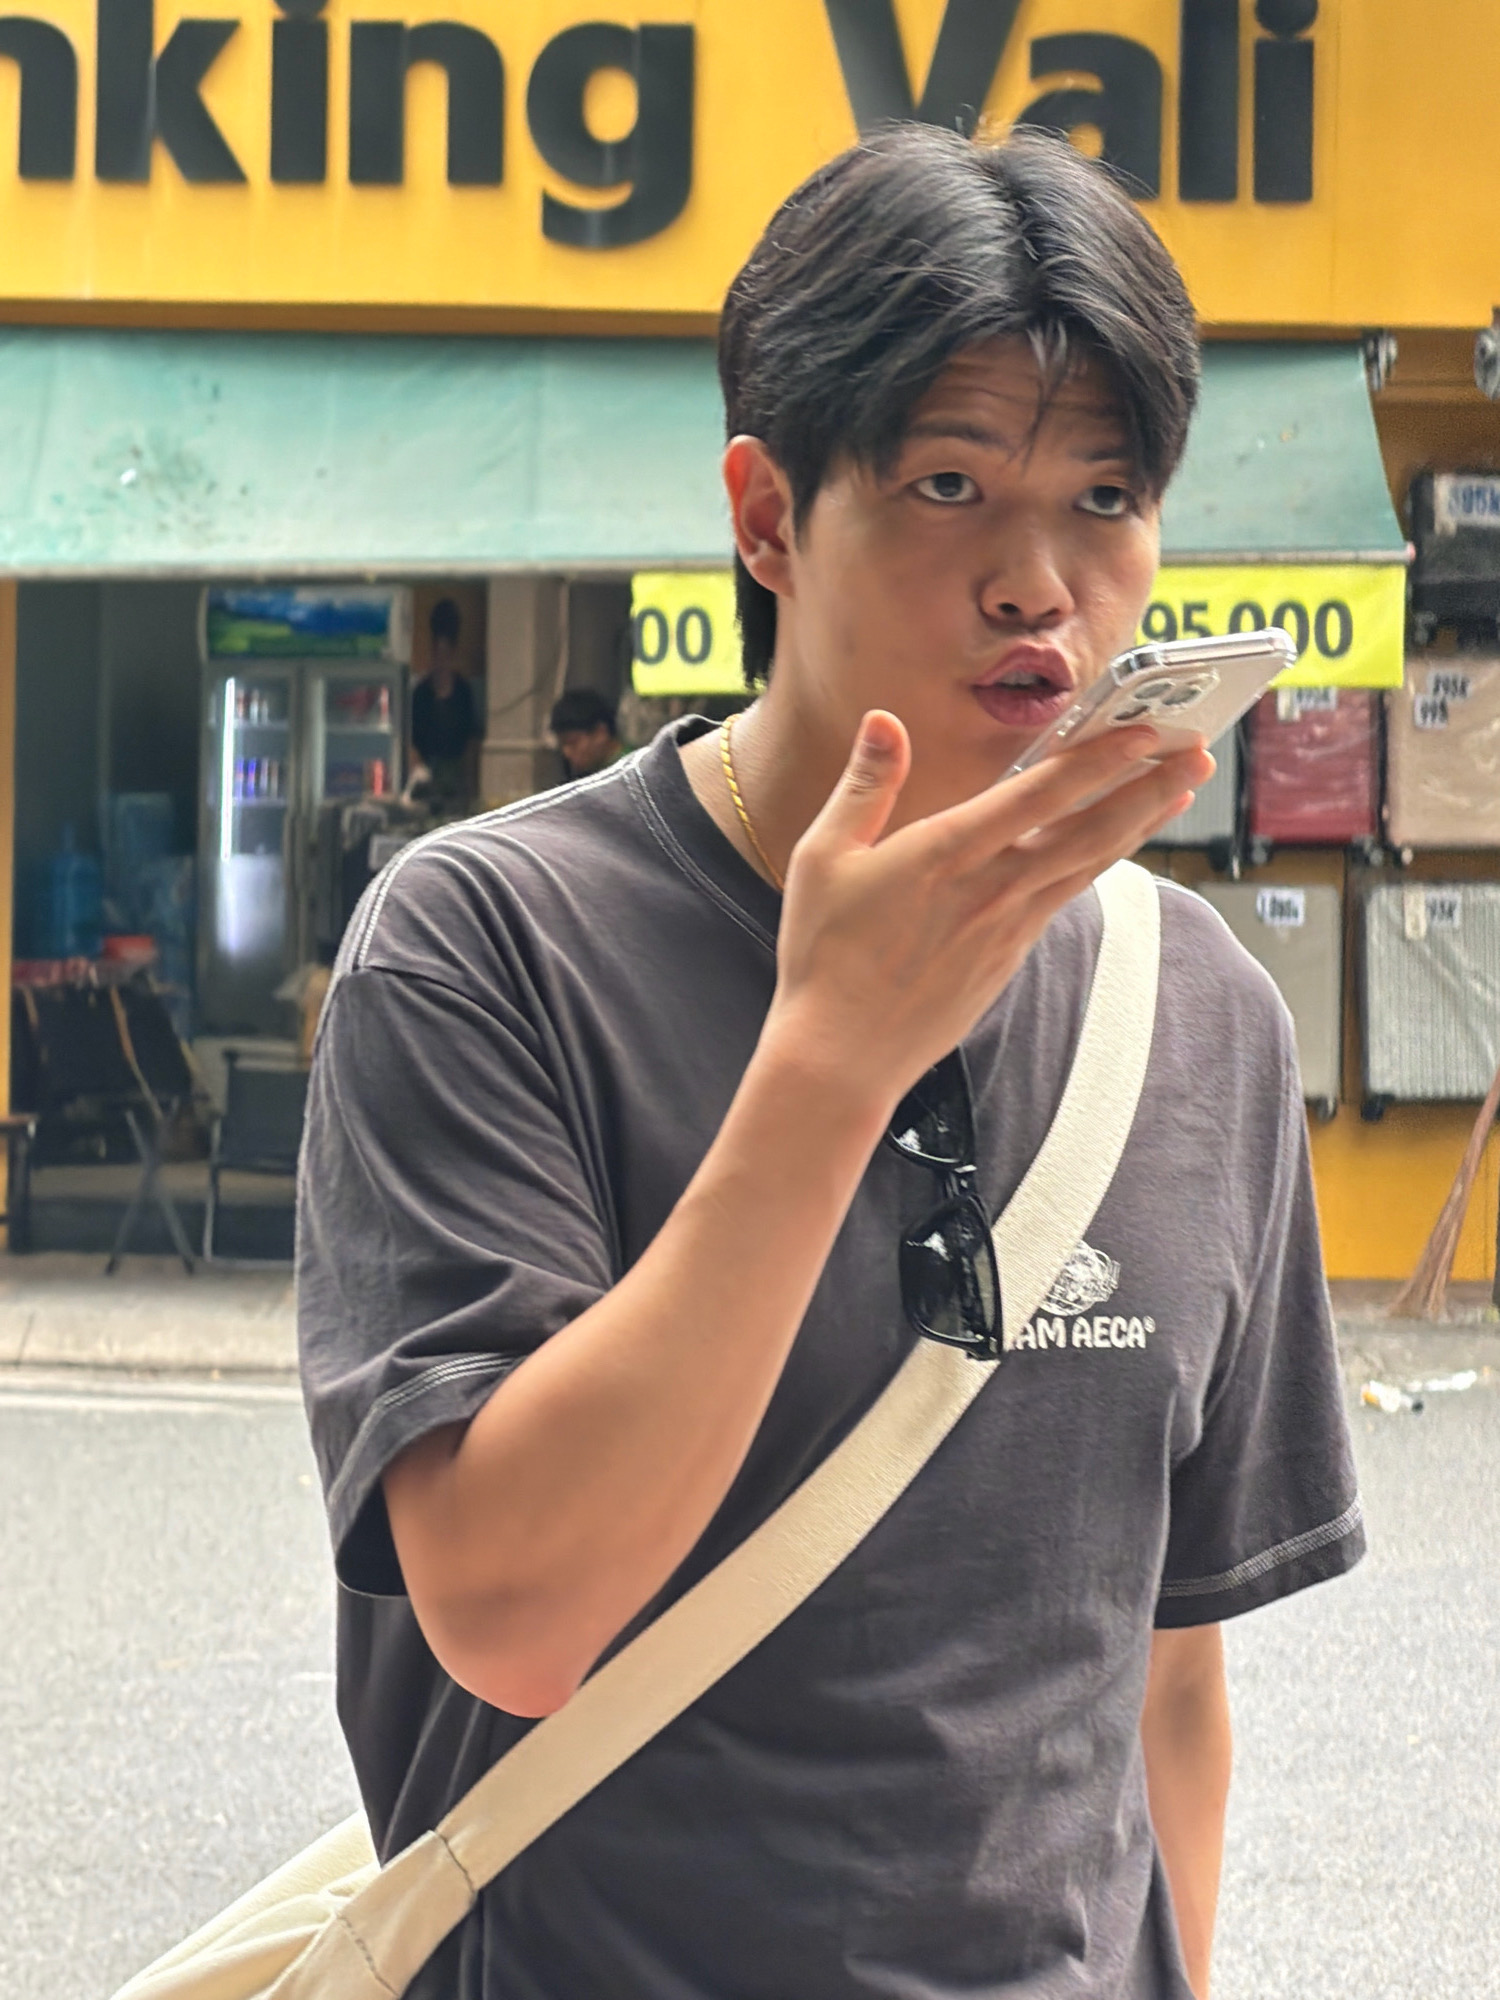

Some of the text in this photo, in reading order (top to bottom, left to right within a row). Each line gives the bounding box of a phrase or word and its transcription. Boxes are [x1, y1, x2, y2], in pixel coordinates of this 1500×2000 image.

[822, 0, 1316, 203] Vali
[1141, 599, 1353, 658] 95000
[1009, 1316, 1067, 1350] AM
